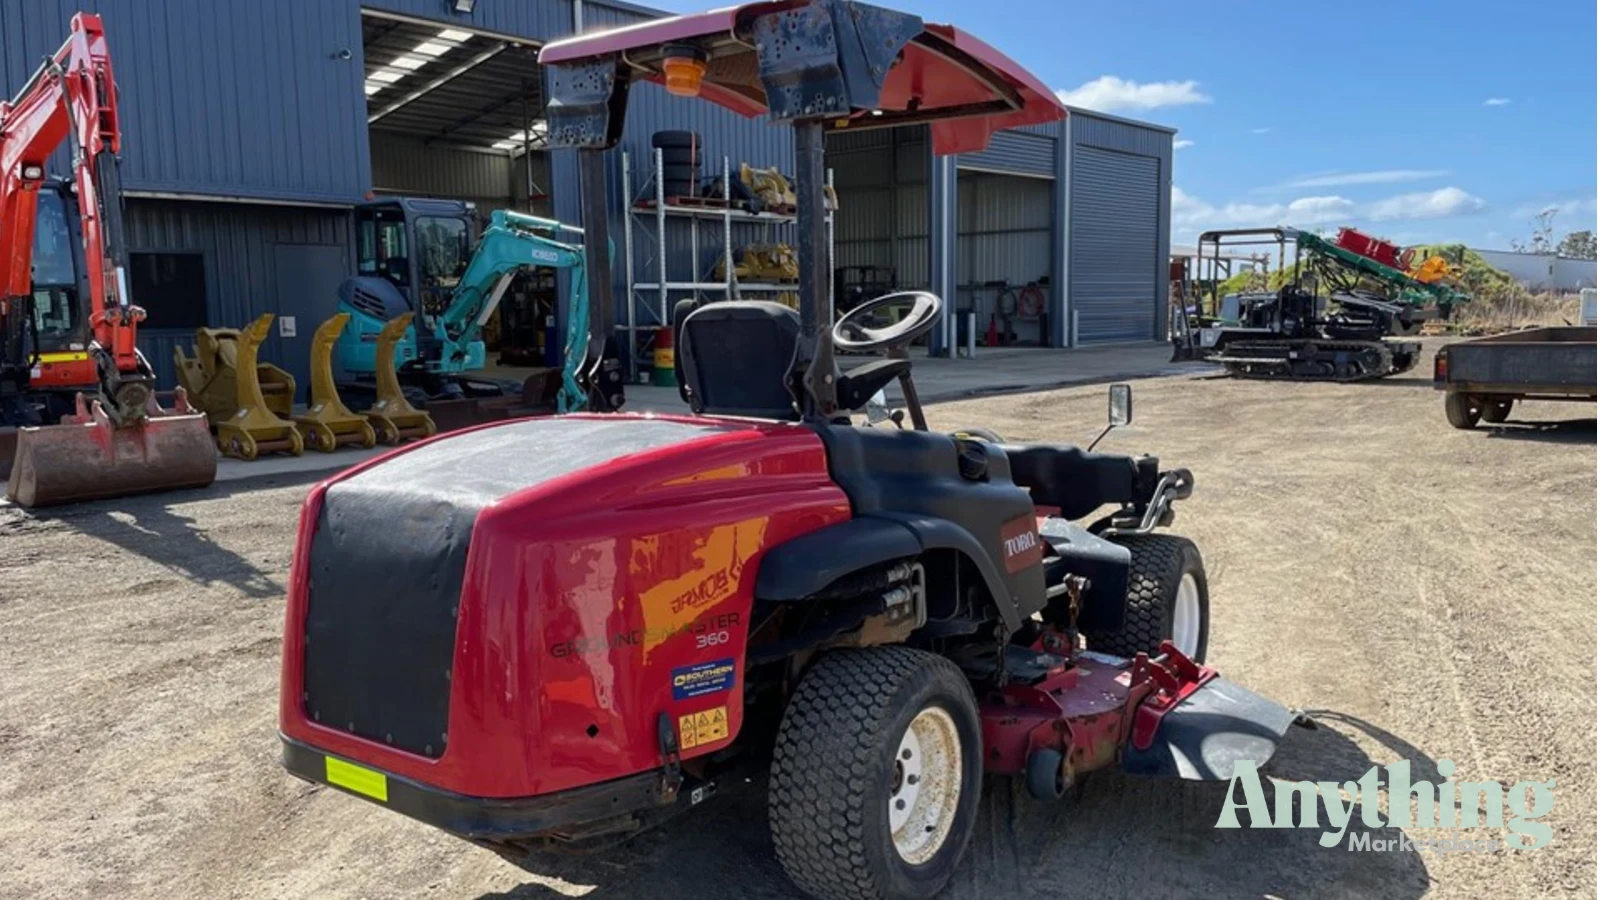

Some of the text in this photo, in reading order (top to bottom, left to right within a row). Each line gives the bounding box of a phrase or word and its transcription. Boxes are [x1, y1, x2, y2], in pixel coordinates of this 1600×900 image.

[1004, 531, 1036, 557] TORO
[696, 631, 729, 649] 360
[685, 665, 734, 681] SOUTHERN
